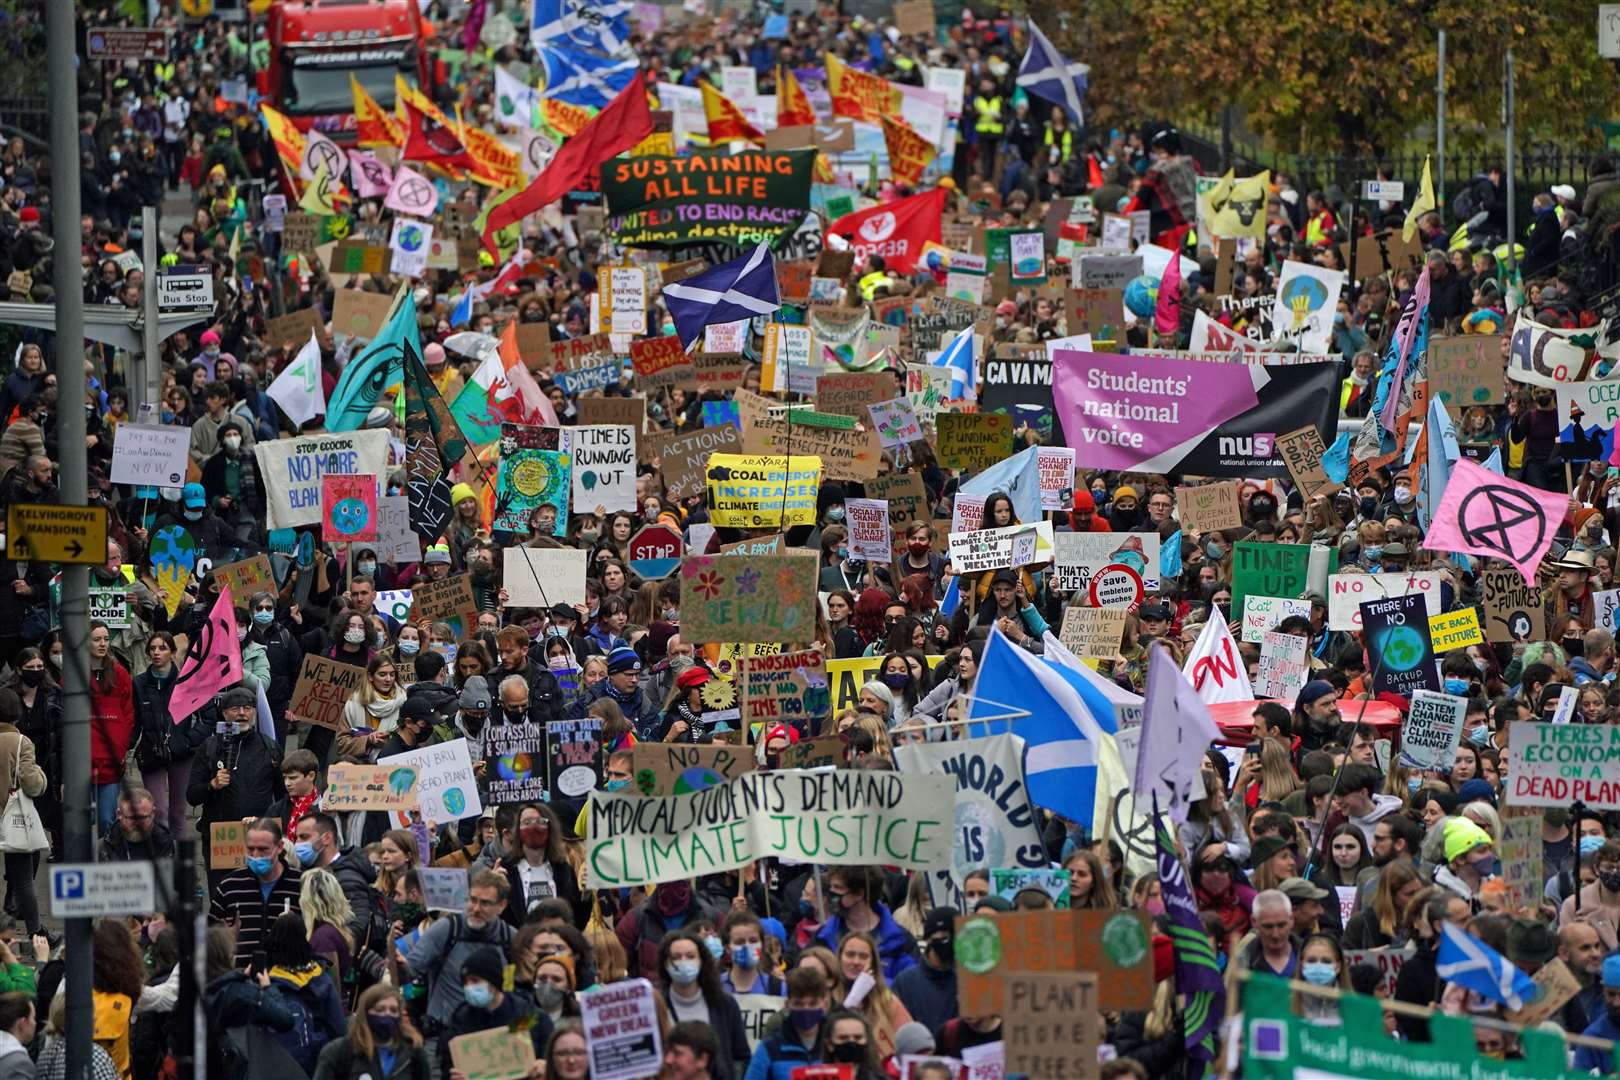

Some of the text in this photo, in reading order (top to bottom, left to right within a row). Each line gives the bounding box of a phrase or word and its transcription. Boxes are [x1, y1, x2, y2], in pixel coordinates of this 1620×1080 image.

[615, 154, 793, 182] SUSTAINING
[645, 175, 768, 201] ALL LIFE
[611, 203, 743, 231] UNITED TO END
[163, 294, 208, 303] Bus Stop
[565, 364, 619, 392] DAMAGE
[1083, 398, 1179, 424] national
[943, 416, 982, 431] STOP
[578, 429, 614, 445] TIME
[616, 429, 631, 445] IS
[662, 426, 738, 459] ACTIONS
[946, 431, 999, 445] FUNDING
[1082, 426, 1145, 450] voice
[296, 443, 318, 454] STOP
[941, 446, 986, 458] CLIMATE
[1219, 434, 1273, 457] nus
[576, 448, 634, 466] RUNNING
[130, 461, 168, 475] NOW
[287, 455, 311, 483] NO
[731, 470, 818, 482] COAL ENERGY
[669, 472, 699, 496] BLAH
[288, 486, 318, 511] BLAH
[718, 500, 817, 511] CLIMATE EMERGENCY
[16, 509, 97, 522] KELVINGROVE
[849, 507, 885, 516] SOCIALIST
[853, 514, 882, 522] CHANGE
[1195, 508, 1235, 521] GREENER
[26, 522, 87, 536] MANSIONS
[853, 527, 885, 536] CLIMATE
[1198, 518, 1236, 531] FUTURE
[854, 534, 885, 542] CHANGE
[967, 529, 996, 539] ACT ON
[952, 537, 983, 547] CLIMATE
[1020, 538, 1033, 546] NOW
[976, 551, 1001, 560] EARTH
[1238, 546, 1298, 573] TIME
[1103, 575, 1128, 587] save
[1263, 575, 1297, 595] UP
[1335, 577, 1432, 593] NO TO
[1099, 586, 1134, 598] embleton
[1101, 594, 1132, 605] beaches
[1247, 597, 1272, 612] Eat
[1367, 597, 1415, 616] THERE IS
[1067, 609, 1124, 622] EARTH WILL
[1248, 614, 1266, 627] Not
[1386, 612, 1406, 626] NO
[1449, 615, 1474, 630] BACK
[1065, 622, 1111, 634] SURVIVE
[1060, 634, 1090, 644] CLIMATE
[1443, 628, 1479, 644] FUTURE
[754, 644, 779, 656] BEES
[1067, 644, 1085, 656] WE
[304, 659, 329, 682] WE
[1386, 669, 1424, 684] BACKUP
[776, 682, 798, 694] HAD
[1399, 680, 1428, 694] PLANET
[778, 697, 802, 714] TOO
[1414, 699, 1456, 715] SYSTEM
[1410, 717, 1432, 729] NOT
[1412, 708, 1456, 724] CHANGE
[485, 723, 541, 743] COMPASSION
[1408, 727, 1454, 742] CLIMATE
[1536, 723, 1602, 745] THERES
[486, 744, 493, 757] &
[495, 738, 541, 756] SOLIDARITY
[1406, 736, 1451, 750] CHANGE
[434, 750, 456, 766] BRU
[668, 744, 700, 771] NO
[1559, 765, 1602, 779] ON A
[489, 777, 543, 792] FROM THE CORE
[942, 751, 1034, 830] WORLD
[1516, 775, 1569, 797] DEAD
[496, 790, 543, 803] STARS ABOVE
[592, 772, 905, 840] MEDICAL STUDENTS DEMAND
[215, 827, 237, 840] NO
[590, 815, 942, 885] CLIMATE JUSTICE
[962, 825, 985, 863] IS
[62, 873, 80, 897] P
[1046, 876, 1064, 889] NO
[585, 985, 646, 1010] SOCIALIST
[1012, 981, 1094, 1011] PLANT
[598, 1003, 640, 1021] GREEN
[590, 1016, 652, 1039] NEW DEAL
[1011, 1022, 1085, 1045] MORE
[1014, 1055, 1088, 1080] TREES
